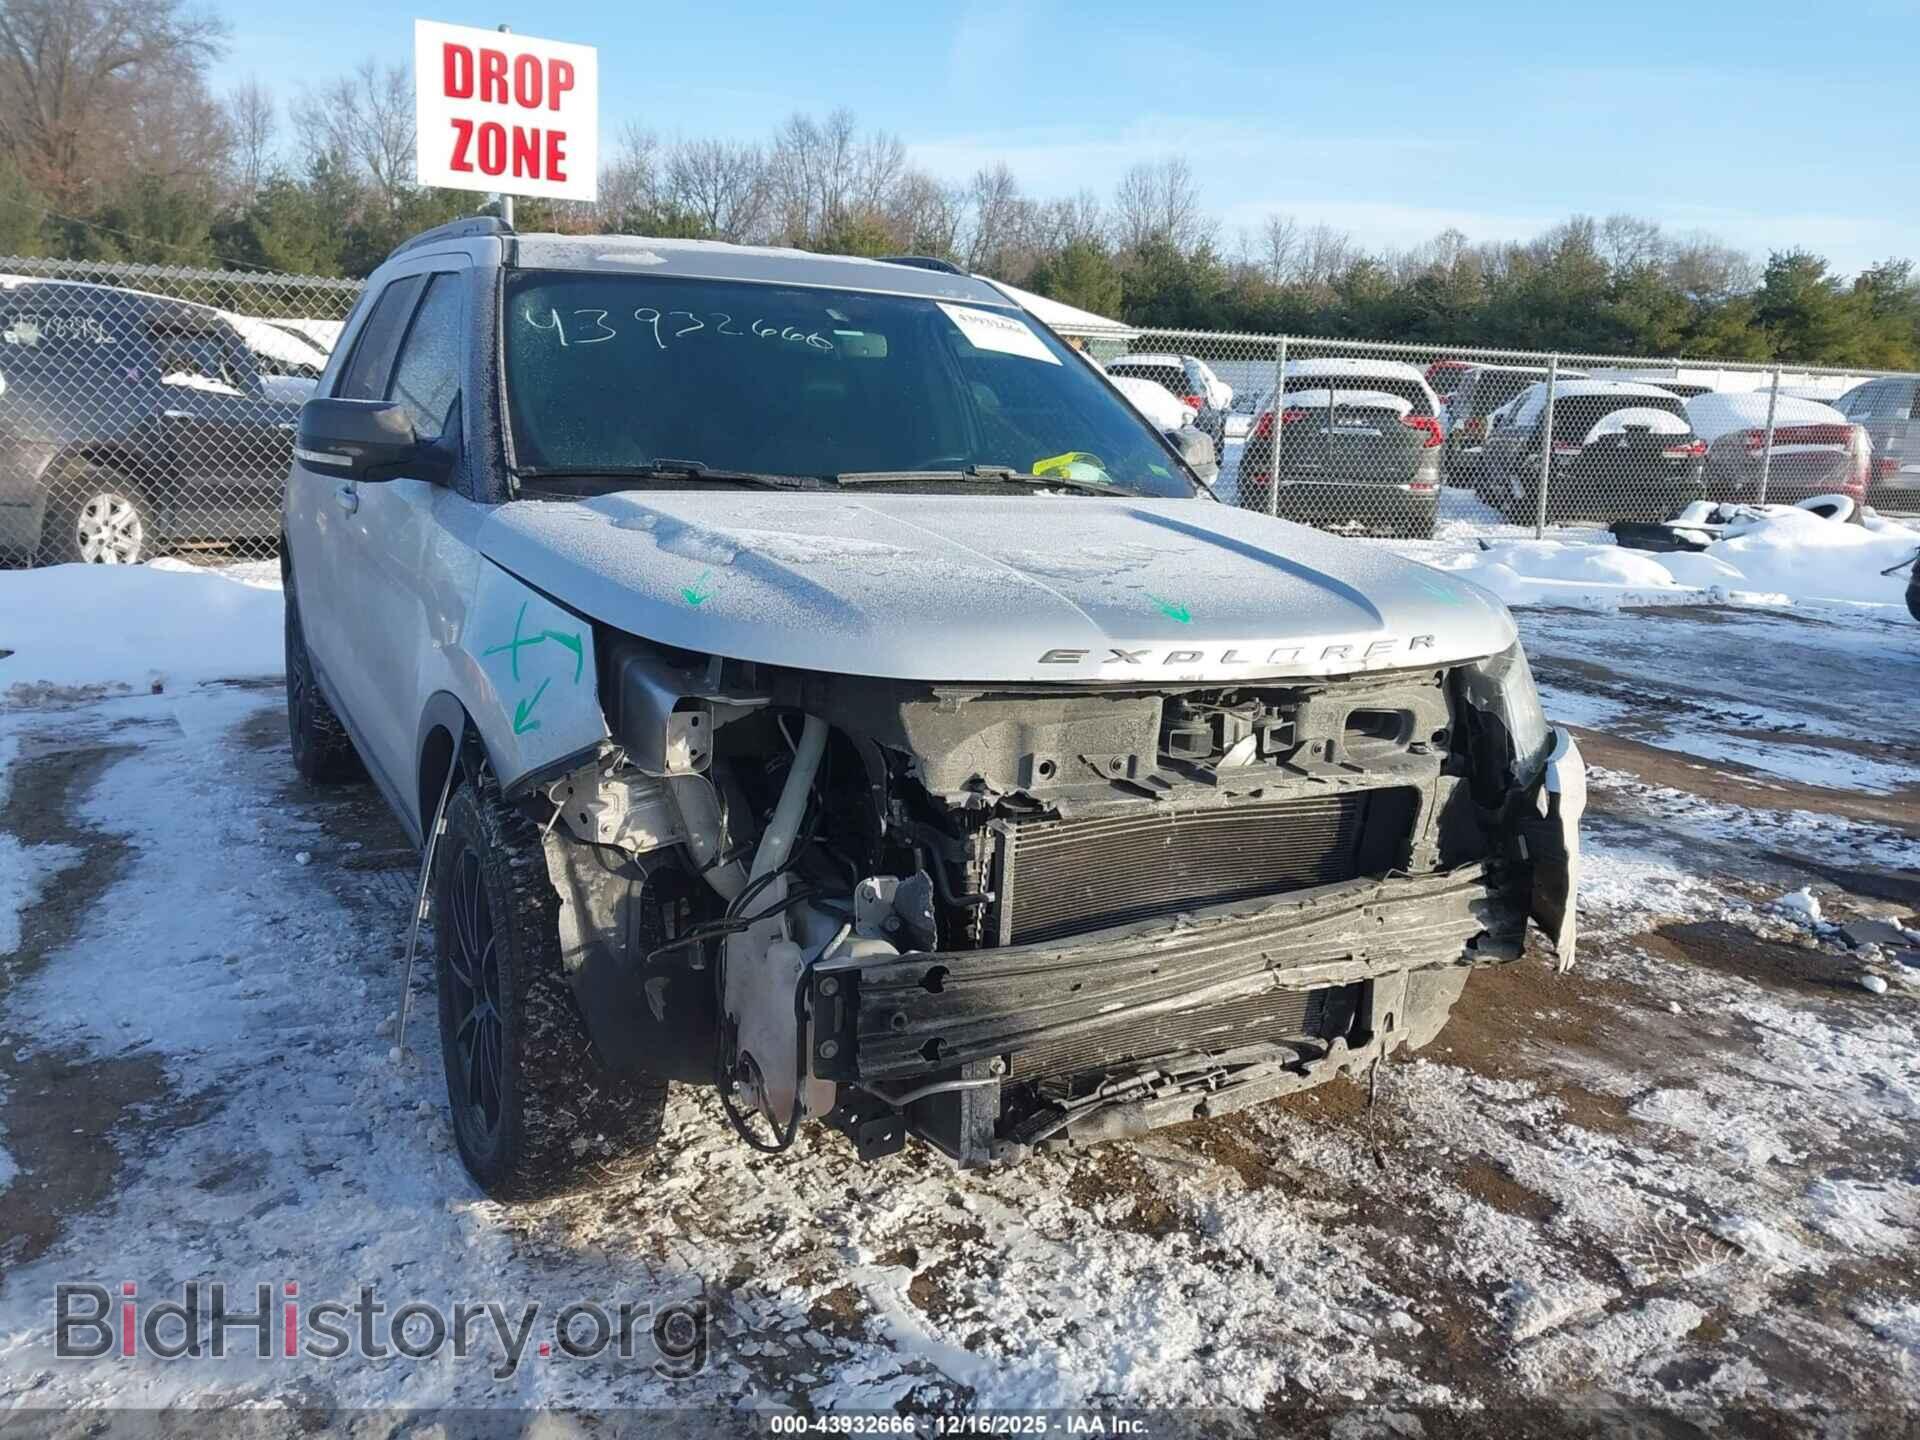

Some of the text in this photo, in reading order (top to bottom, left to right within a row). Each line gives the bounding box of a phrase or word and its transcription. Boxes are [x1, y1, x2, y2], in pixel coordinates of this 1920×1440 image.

[443, 42, 575, 112] DROP
[450, 117, 568, 183] ZONE
[1036, 633, 1437, 666] EXPLORER
